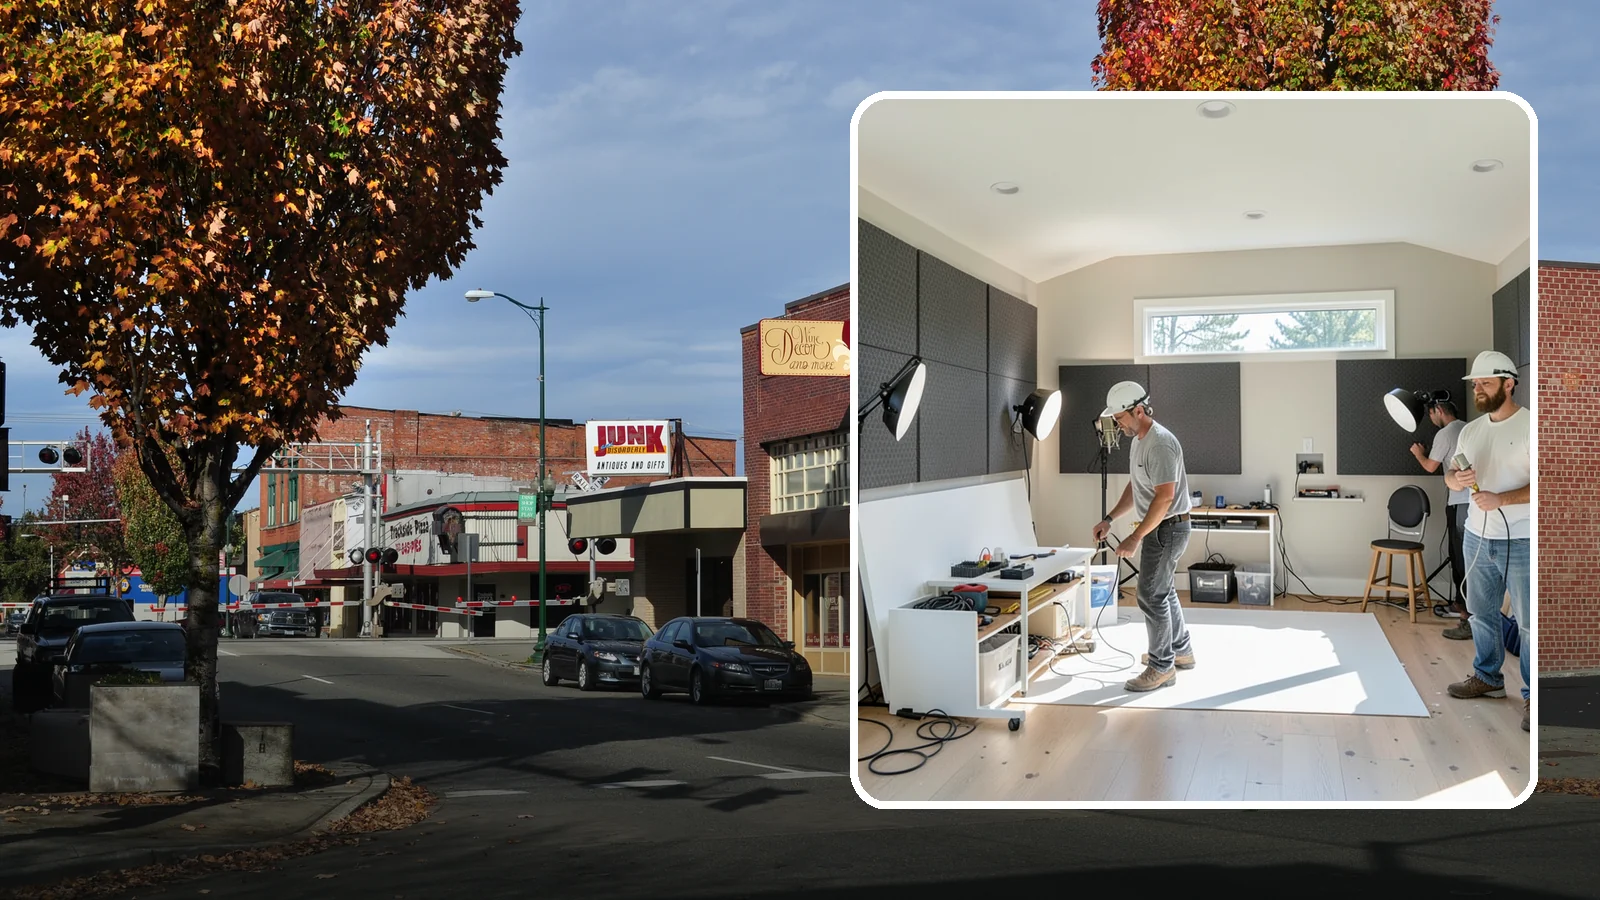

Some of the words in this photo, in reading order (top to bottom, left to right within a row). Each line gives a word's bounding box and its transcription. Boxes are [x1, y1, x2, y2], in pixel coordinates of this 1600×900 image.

[595, 425, 665, 457] JUNK
[597, 461, 628, 470] ANTIQUES
[631, 461, 643, 470] AND
[647, 460, 665, 470] GIFTS
[390, 521, 412, 540] Trackside
[414, 519, 429, 535] Pizza
